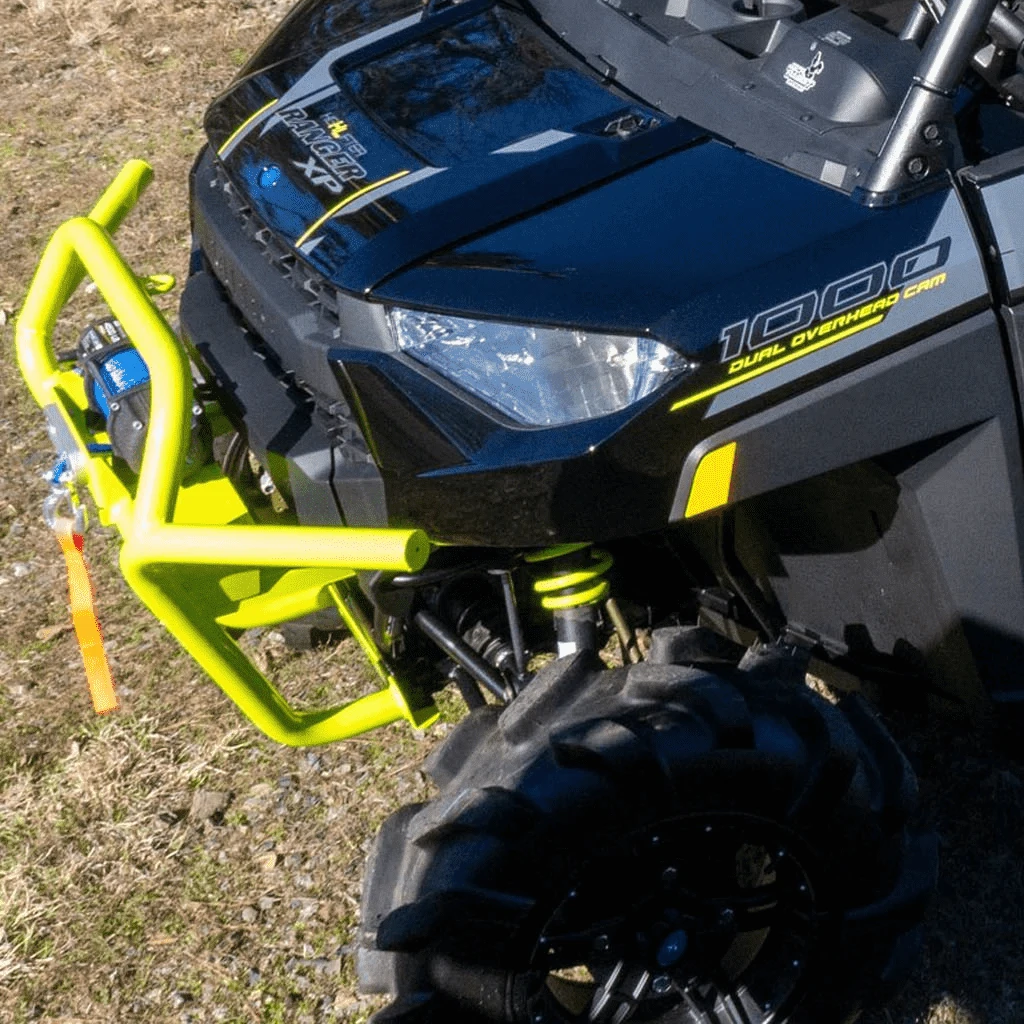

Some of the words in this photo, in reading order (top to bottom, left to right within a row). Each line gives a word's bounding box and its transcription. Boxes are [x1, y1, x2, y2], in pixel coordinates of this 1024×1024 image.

[275, 107, 368, 182] RANGER
[292, 155, 344, 193] XP
[719, 236, 952, 363] 1000
[728, 342, 786, 375] DUAL
[791, 292, 899, 347] OVERHEAD
[902, 272, 946, 300] CAM
